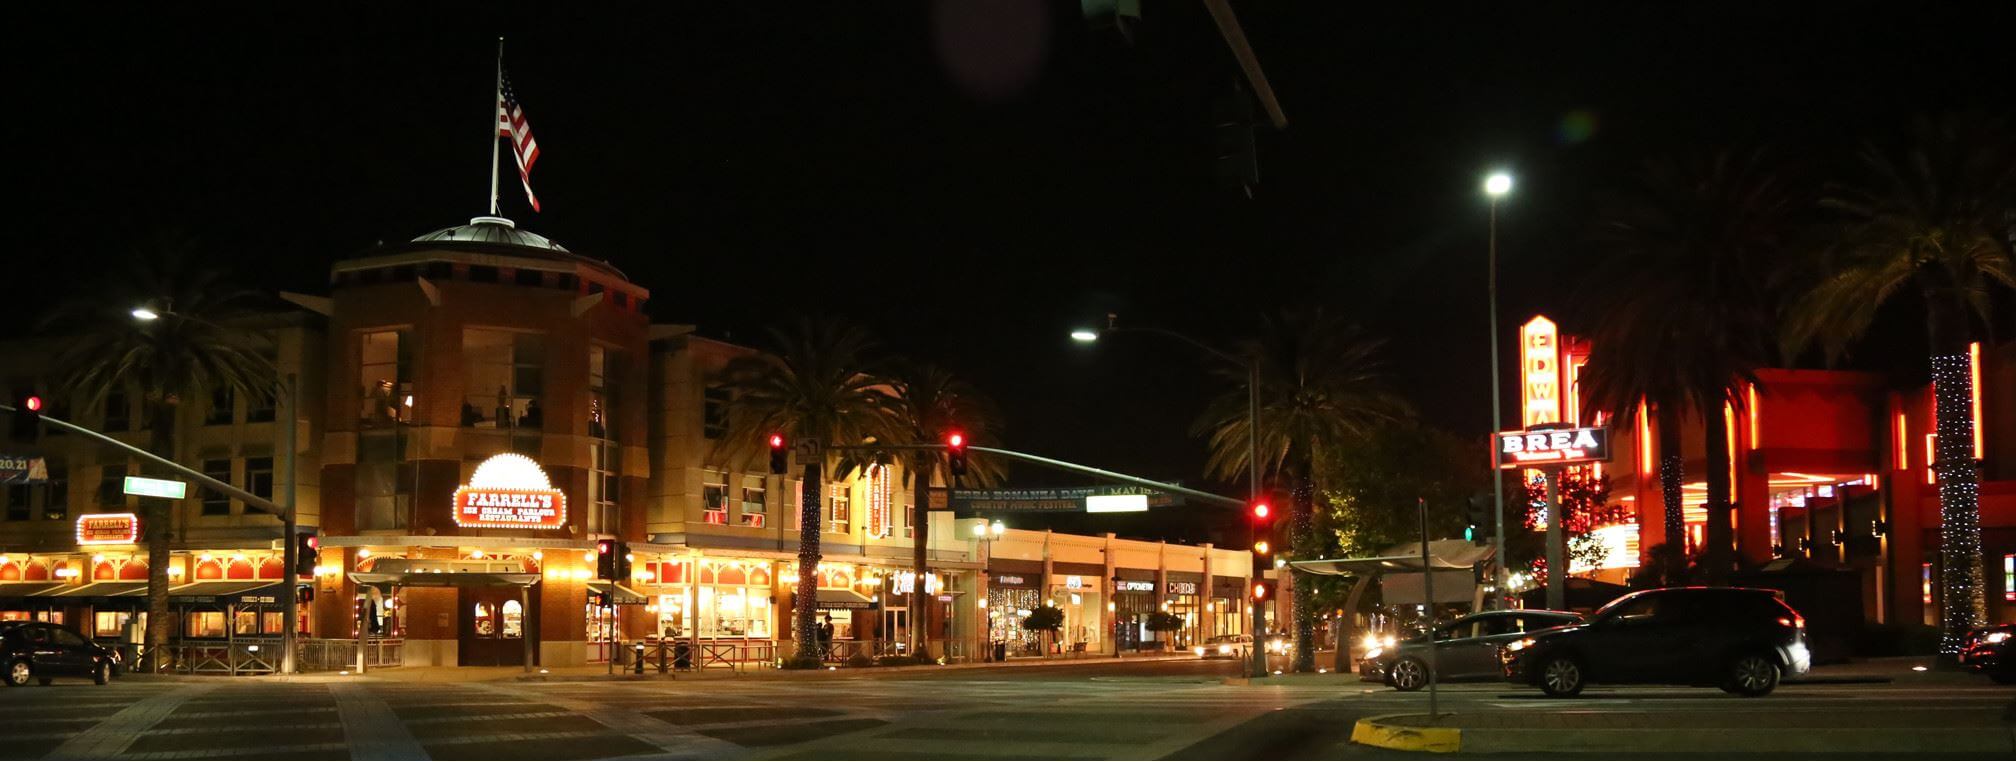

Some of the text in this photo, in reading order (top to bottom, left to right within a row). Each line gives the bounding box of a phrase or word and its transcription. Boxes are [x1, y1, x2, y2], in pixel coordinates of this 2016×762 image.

[1503, 430, 1598, 453] BREA
[992, 490, 1058, 499] BONANZA
[1110, 486, 1137, 495] MAY
[468, 493, 552, 508] FARRELL'S
[481, 507, 513, 515] CREAM
[89, 519, 130, 529] FARRELL'S
